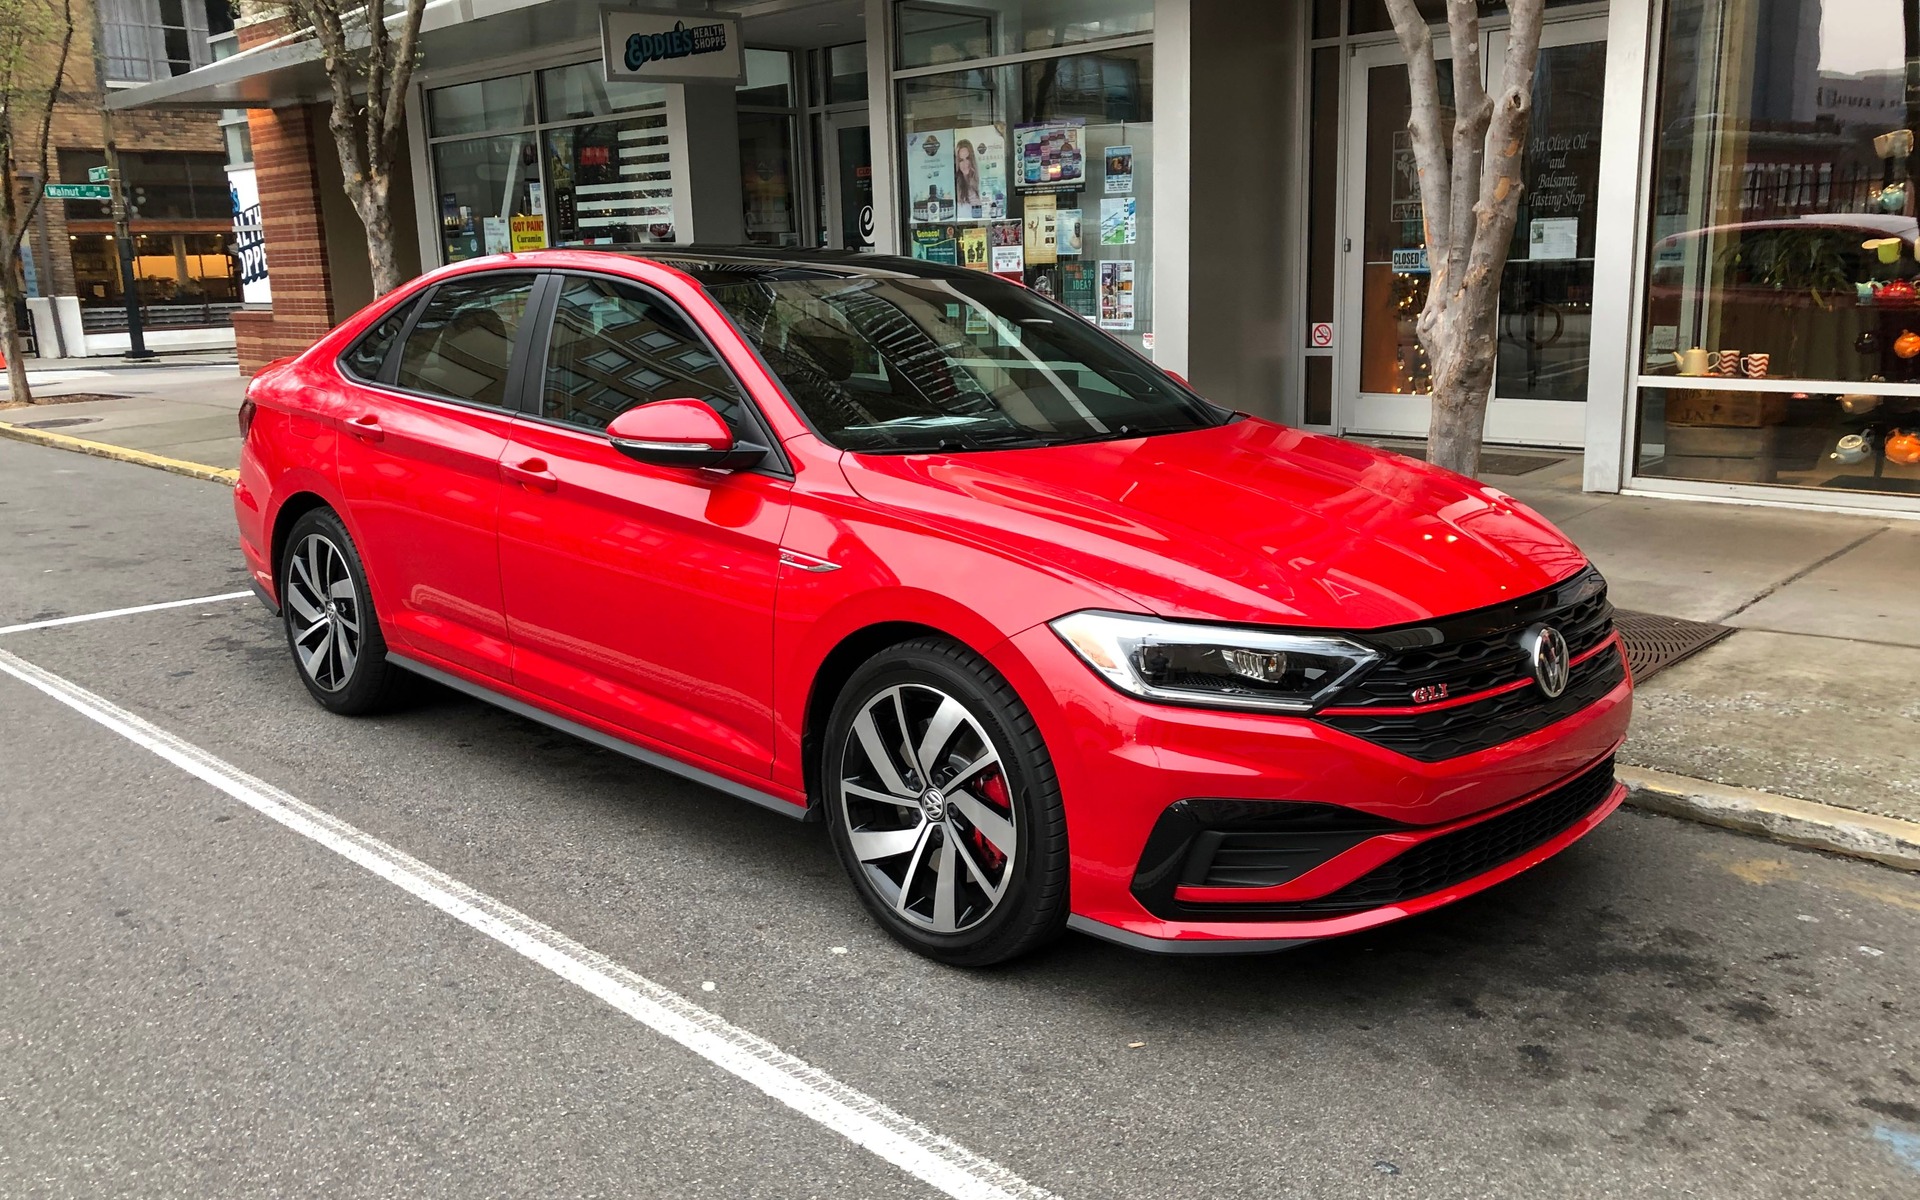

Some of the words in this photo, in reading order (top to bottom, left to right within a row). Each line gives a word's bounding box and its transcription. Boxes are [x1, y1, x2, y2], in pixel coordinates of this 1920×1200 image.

[693, 26, 724, 38] HEALTH
[694, 37, 726, 50] SHOPPE
[1531, 138, 1545, 153] An
[1547, 134, 1570, 152] Olive
[1573, 132, 1589, 149] Oil
[1549, 152, 1567, 169] and
[1538, 171, 1578, 188] Balsamic
[48, 186, 80, 197] Walnut
[1529, 191, 1562, 212] Tasting
[1563, 188, 1585, 211] Shop
[512, 221, 525, 232] GOT
[526, 220, 544, 232] PAIN?
[517, 233, 542, 243] Curamin
[1394, 252, 1420, 265] CLOSED
[1082, 269, 1094, 279] BIG
[1072, 280, 1092, 290] IDEA?
[1412, 683, 1448, 703] GLI
